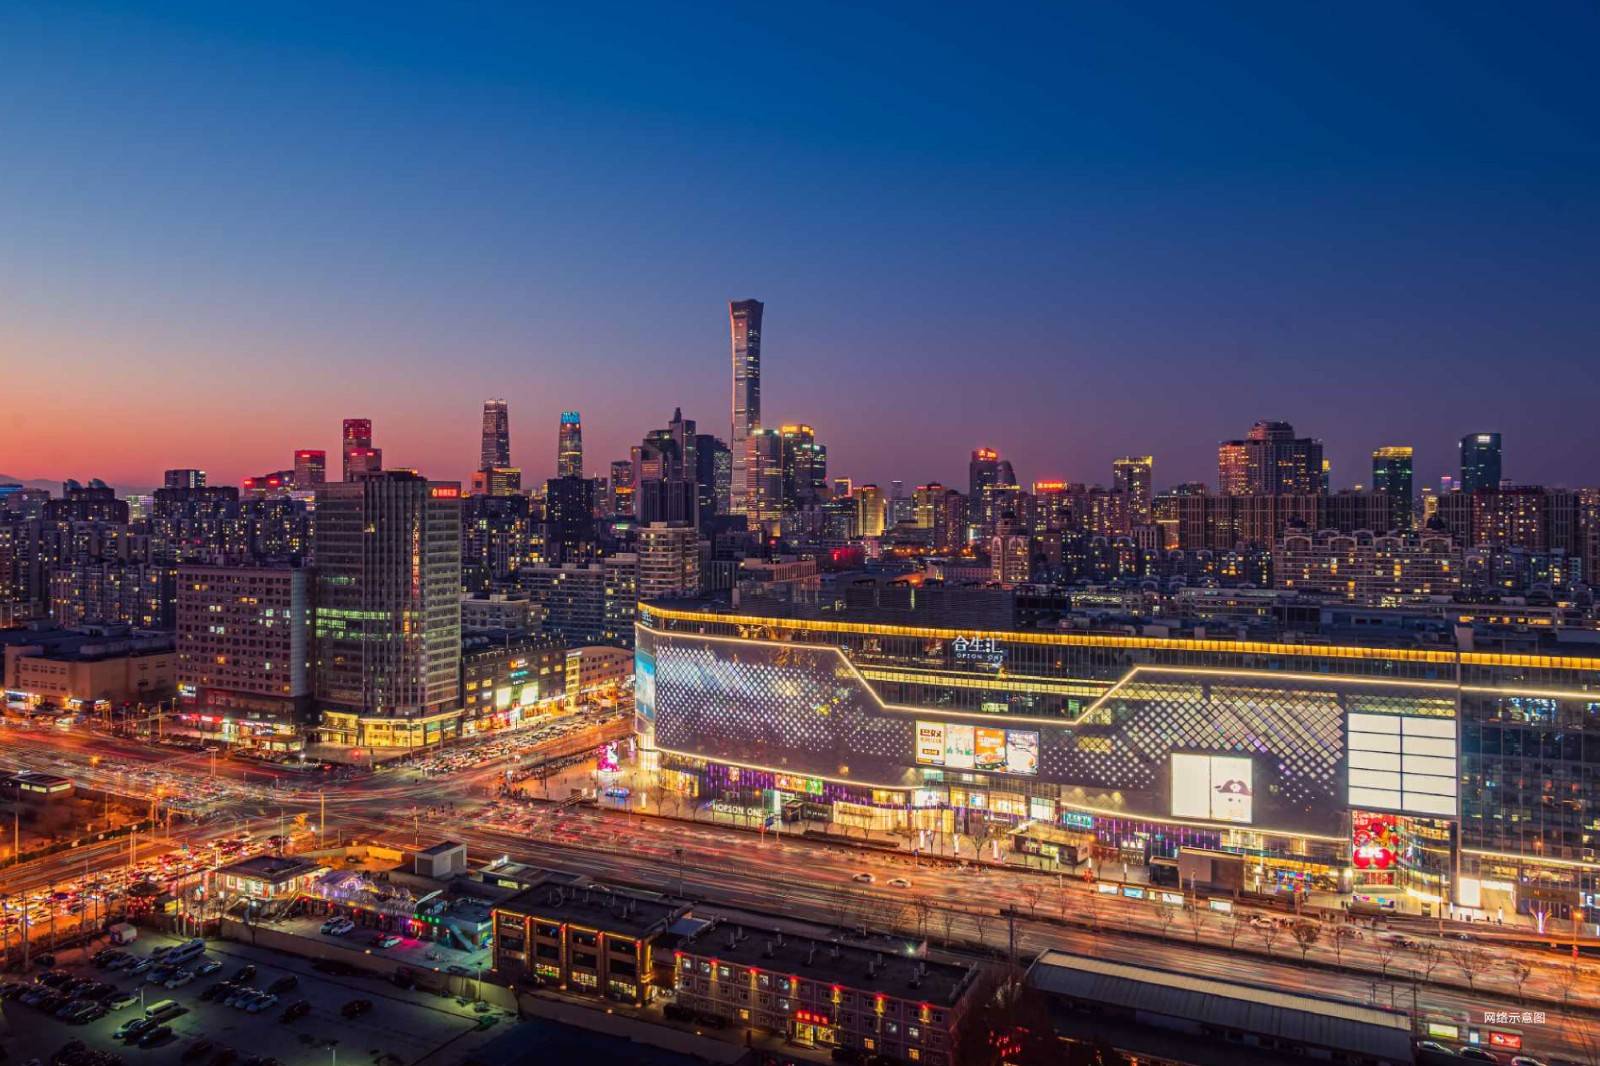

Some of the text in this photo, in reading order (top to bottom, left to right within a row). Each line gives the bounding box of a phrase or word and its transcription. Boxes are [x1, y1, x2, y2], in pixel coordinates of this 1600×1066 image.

[951, 635, 1003, 653] 合生汇
[713, 803, 763, 817] HOPSON ONE
